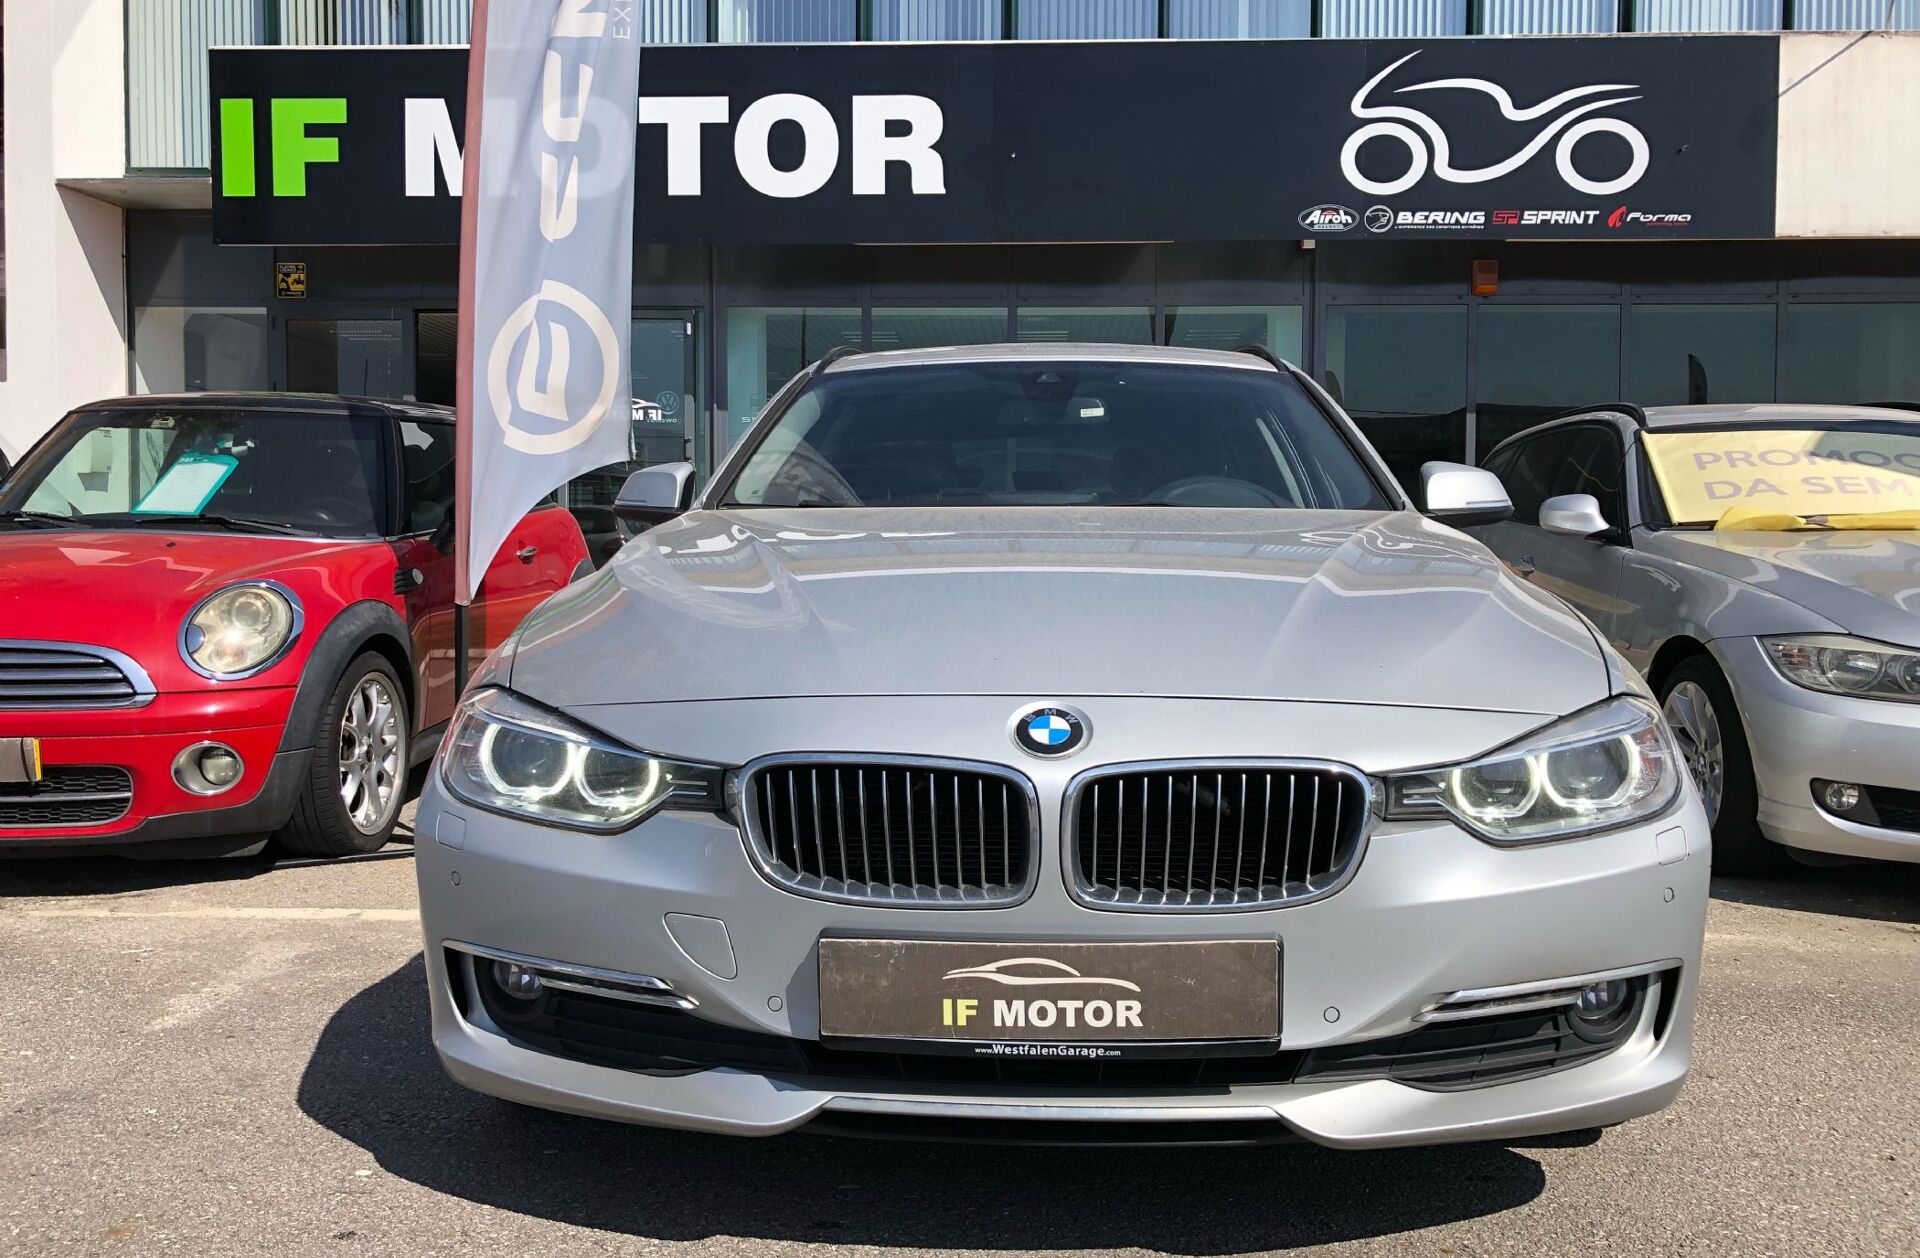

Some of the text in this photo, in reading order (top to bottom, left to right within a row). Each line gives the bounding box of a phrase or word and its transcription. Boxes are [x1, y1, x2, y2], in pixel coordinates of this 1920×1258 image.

[220, 97, 347, 197] IF
[1304, 209, 1353, 224] Airoh
[1395, 211, 1486, 224] BERING
[1521, 210, 1600, 225] SPRINT
[1626, 212, 1692, 222] Forma
[1703, 477, 1787, 500] DA
[1023, 708, 1079, 724] BMW
[942, 998, 1144, 1028] IF MOTOR
[974, 1043, 1122, 1058] www.WestfalenGarage.com
